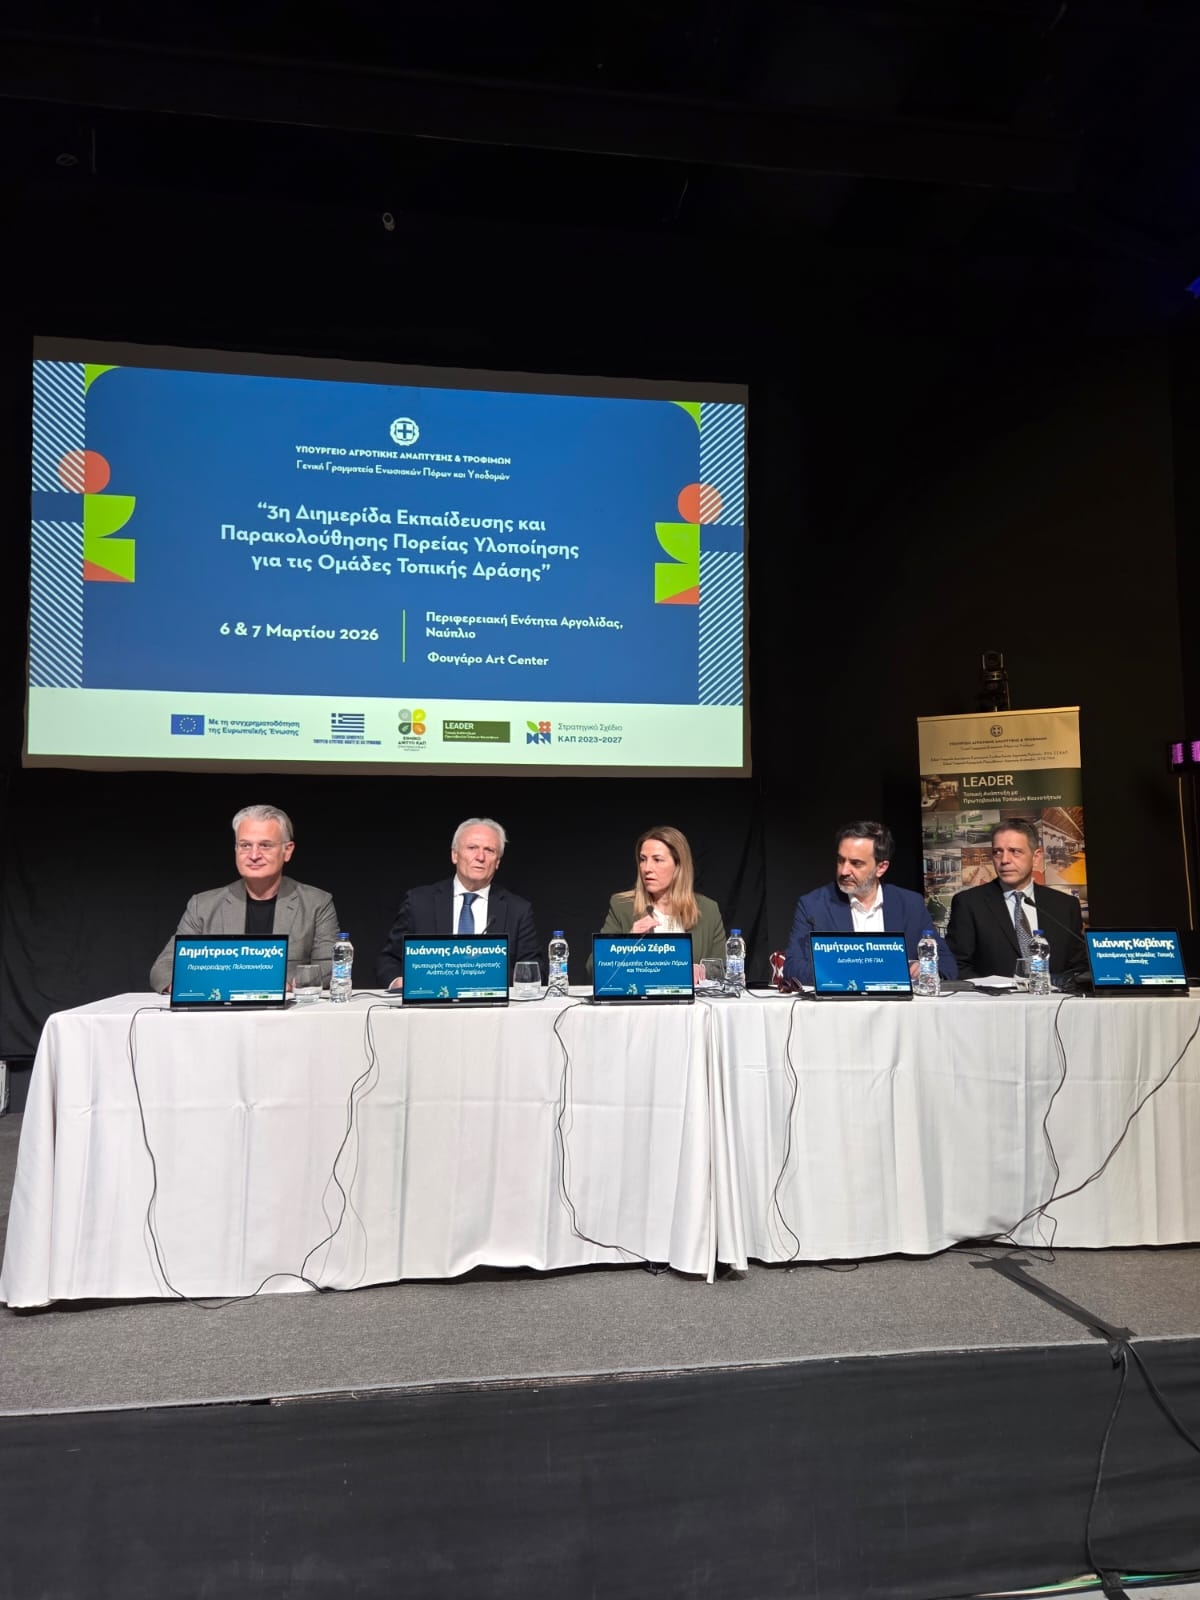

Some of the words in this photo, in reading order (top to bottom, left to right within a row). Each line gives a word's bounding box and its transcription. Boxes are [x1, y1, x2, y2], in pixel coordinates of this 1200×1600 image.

[295, 445, 347, 456] ΥΠΟΥΡΓΕΙΟ
[348, 448, 398, 459] ΑΓΡΟΤΙΚΗΣ
[399, 452, 453, 462] ΑΝΑΠΤΥΞΗΣ
[454, 455, 461, 463] &
[462, 455, 511, 465] ΤΡΟΦΙΜΩΝ
[296, 459, 324, 471] Γενική
[325, 461, 374, 475] Γραμματεία
[375, 464, 422, 477] Ενωσιακών
[422, 467, 452, 480] Πόρων
[467, 469, 511, 482] Υποδομών
[295, 504, 392, 527] Διημερίδα
[396, 509, 514, 534] Εκπαίδευσης
[518, 519, 546, 532] και
[221, 524, 388, 552] Παρακολούθησης
[393, 533, 469, 555] Πορείας
[473, 536, 580, 560] Υλοποίησης
[251, 555, 282, 571] για
[286, 557, 313, 572] τις
[317, 554, 392, 576] Ομάδες
[396, 558, 468, 580] Τοπικής
[425, 611, 508, 628] Περιφερειακή
[510, 614, 558, 629] Ενότητα
[560, 616, 624, 630] Αργολίδας,
[219, 622, 231, 636] 6
[234, 621, 248, 636] &
[252, 625, 262, 639] 7
[266, 623, 336, 642] Μαρτίου
[339, 628, 380, 641] 2026
[425, 627, 477, 639] Ναύπλιο
[427, 651, 483, 666] Φουγάρο
[485, 653, 505, 665] Art
[507, 654, 550, 666] Center
[208, 718, 219, 726] Με
[220, 719, 229, 728] τη
[444, 722, 474, 730] LEADER
[558, 722, 599, 732] Στρατηγικό
[599, 722, 623, 732] Σχέδιο
[208, 727, 221, 735] της
[578, 736, 623, 744] 2023-2027
[962, 774, 1015, 788] LEADER
[609, 943, 647, 955] Αργυρώ
[648, 943, 676, 954] Ζέρβα
[814, 941, 865, 953] Δημήτριος
[865, 941, 905, 952] Παππάς
[1092, 937, 1133, 950] Ιωάννης
[1132, 937, 1175, 950] Κοβάνης
[178, 945, 239, 959] Δημήτριος
[241, 945, 284, 958] Πτωχός
[406, 945, 450, 957] Ιωάννης
[452, 945, 507, 957] Ανδριανός
